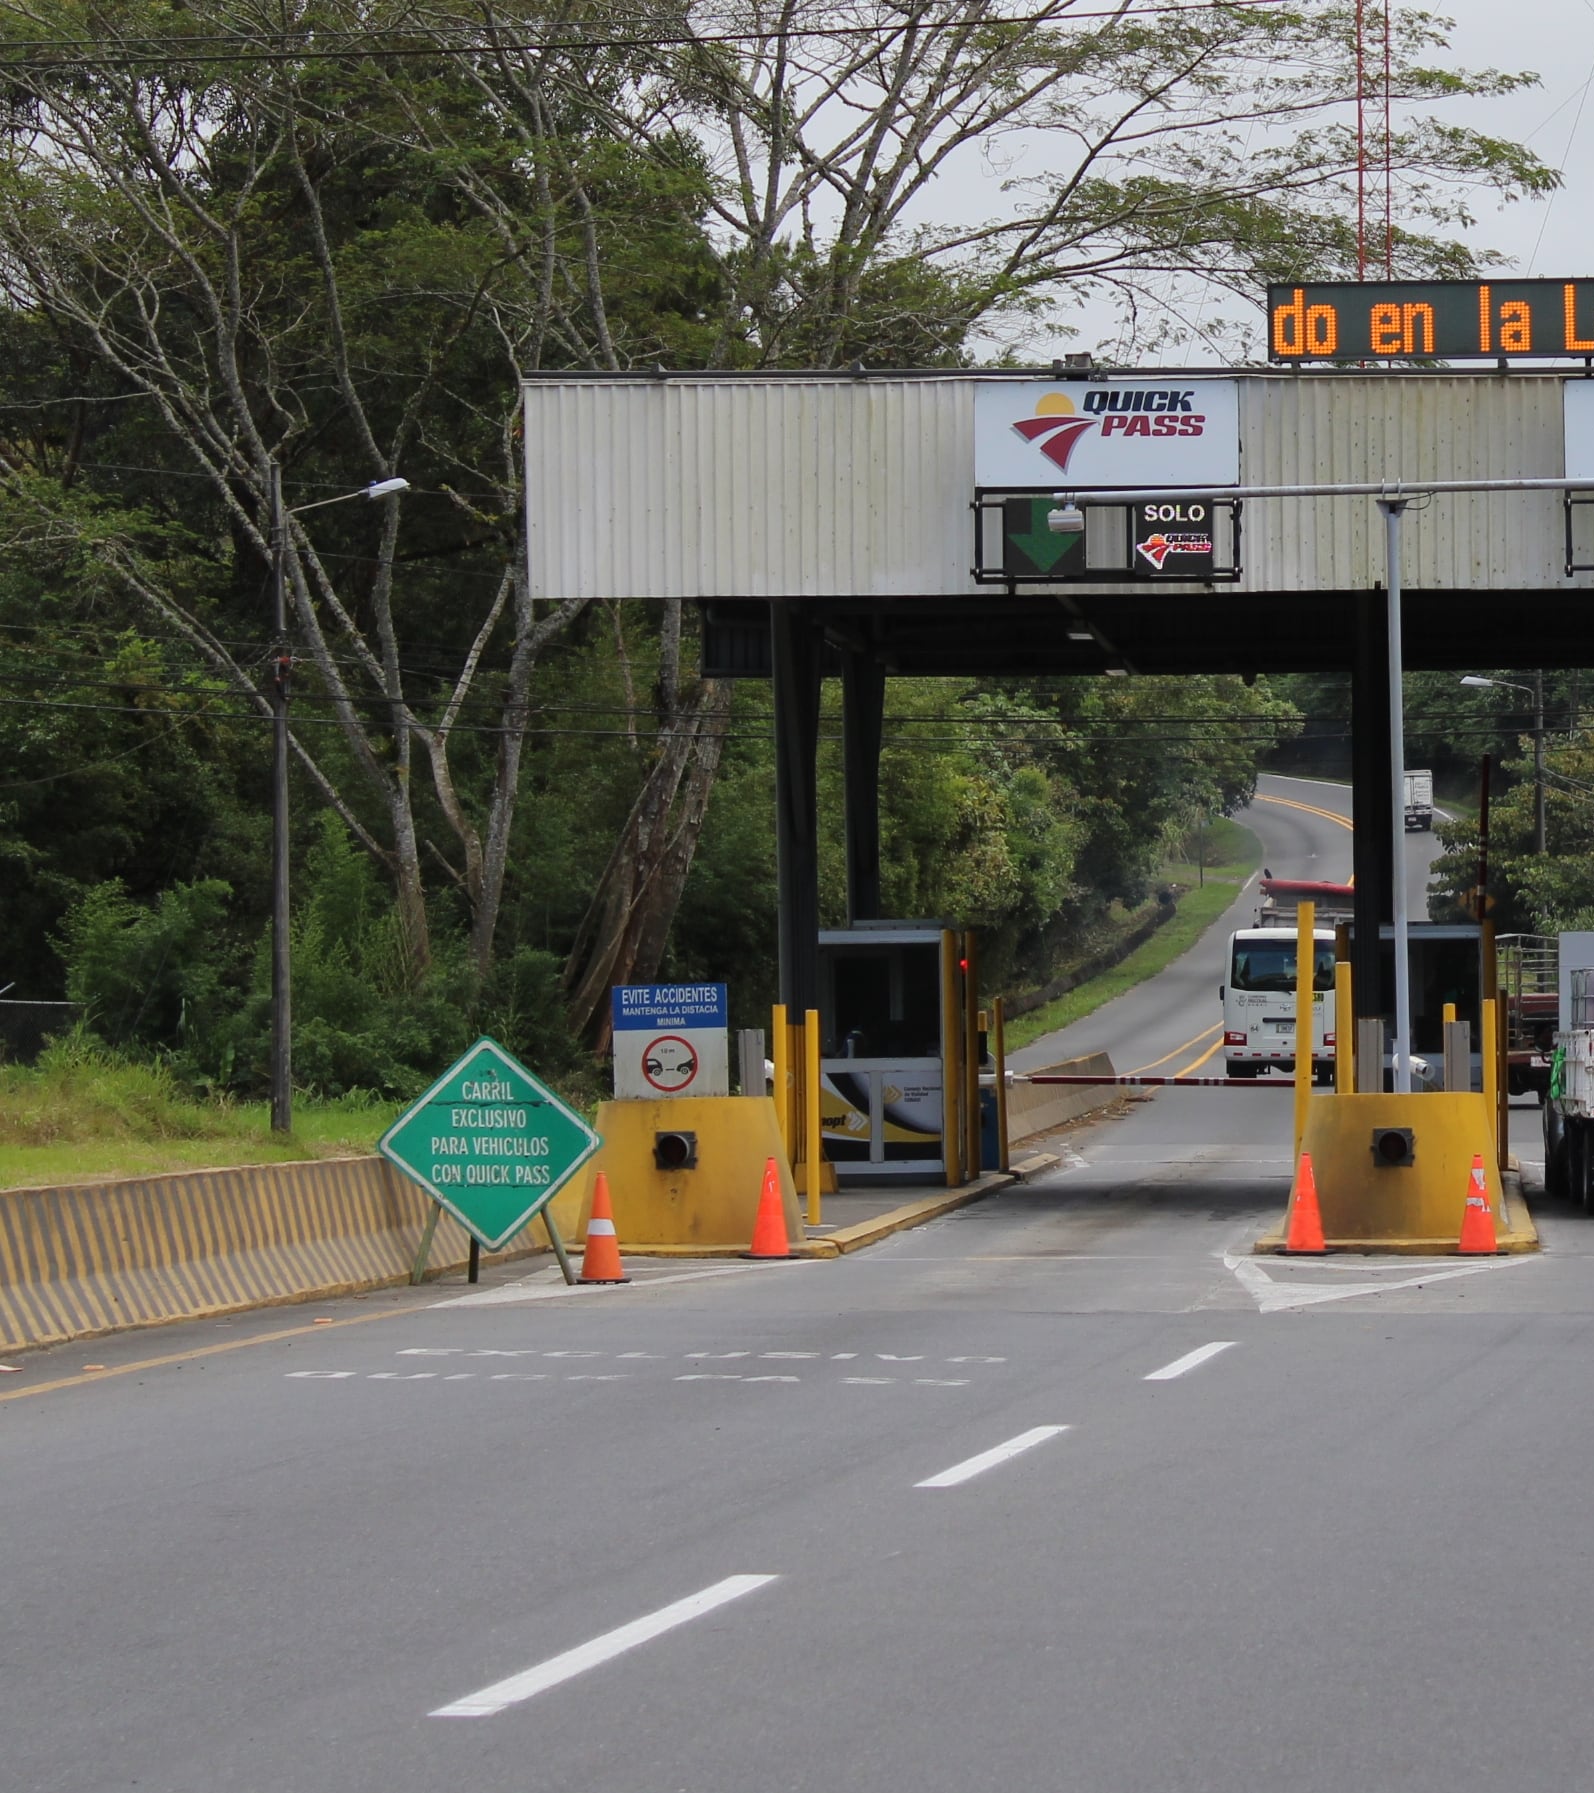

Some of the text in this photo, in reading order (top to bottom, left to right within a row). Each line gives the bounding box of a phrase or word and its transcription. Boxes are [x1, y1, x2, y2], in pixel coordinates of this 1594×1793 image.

[1273, 288, 1337, 355] do
[1370, 303, 1434, 354] en
[1479, 285, 1532, 352] la
[1083, 390, 1195, 415] QUICK
[1101, 415, 1206, 437] PASS
[1144, 504, 1205, 522] SOLO
[622, 987, 718, 1005] EVITE ACCIDENTES
[622, 1005, 718, 1016] MANTENGA LA DISTACIA
[657, 1017, 686, 1026] MINIMA
[462, 1081, 514, 1100] CARRIL
[452, 1109, 526, 1128] EXCLUSIVO
[431, 1136, 549, 1156] PARA VEHICULOS
[431, 1164, 551, 1185] CON QUICK PASS
